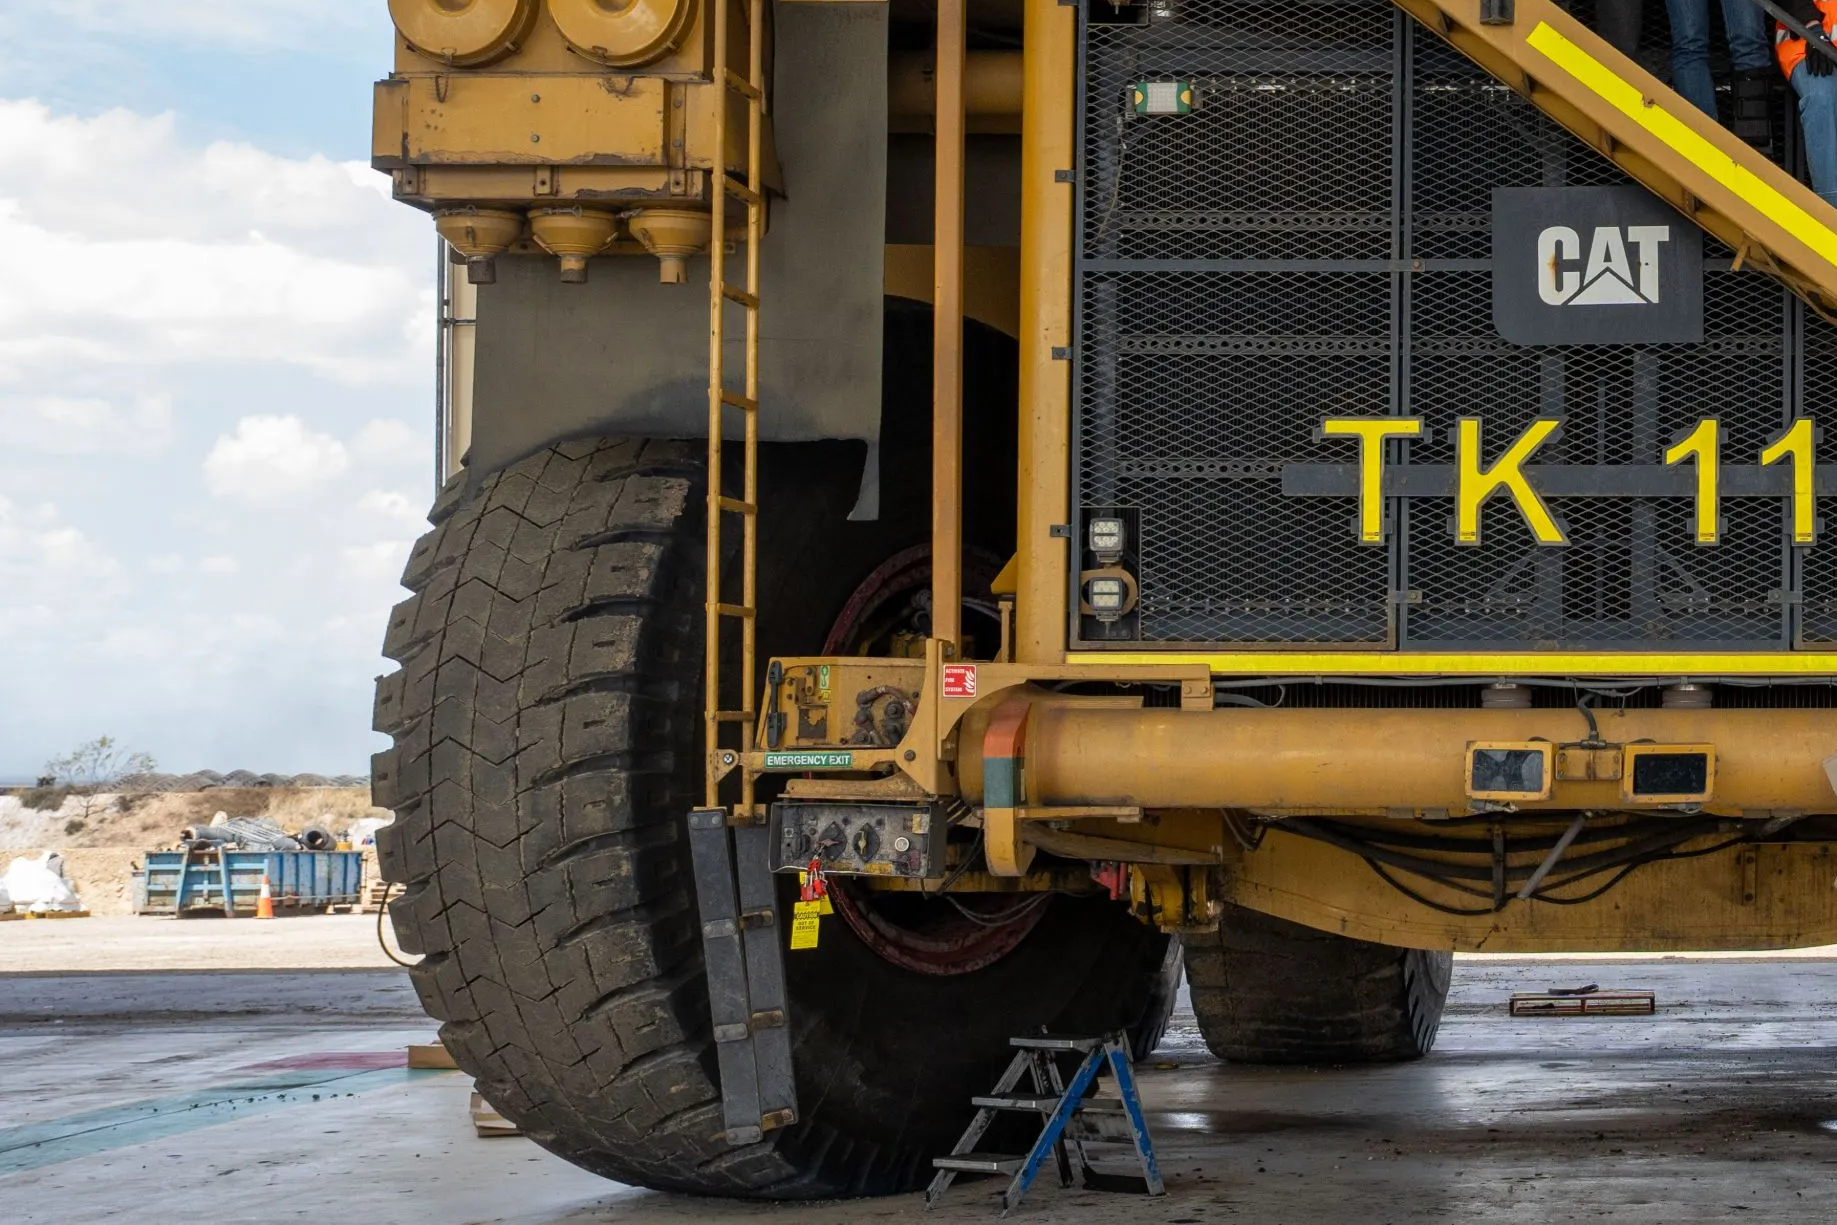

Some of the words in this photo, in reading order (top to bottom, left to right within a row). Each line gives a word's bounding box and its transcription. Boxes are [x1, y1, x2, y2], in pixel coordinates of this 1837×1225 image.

[1538, 225, 1670, 306] CAT
[1666, 419, 1812, 543] 11
[767, 755, 826, 765] EMERGENCY
[829, 755, 850, 765] EXIT
